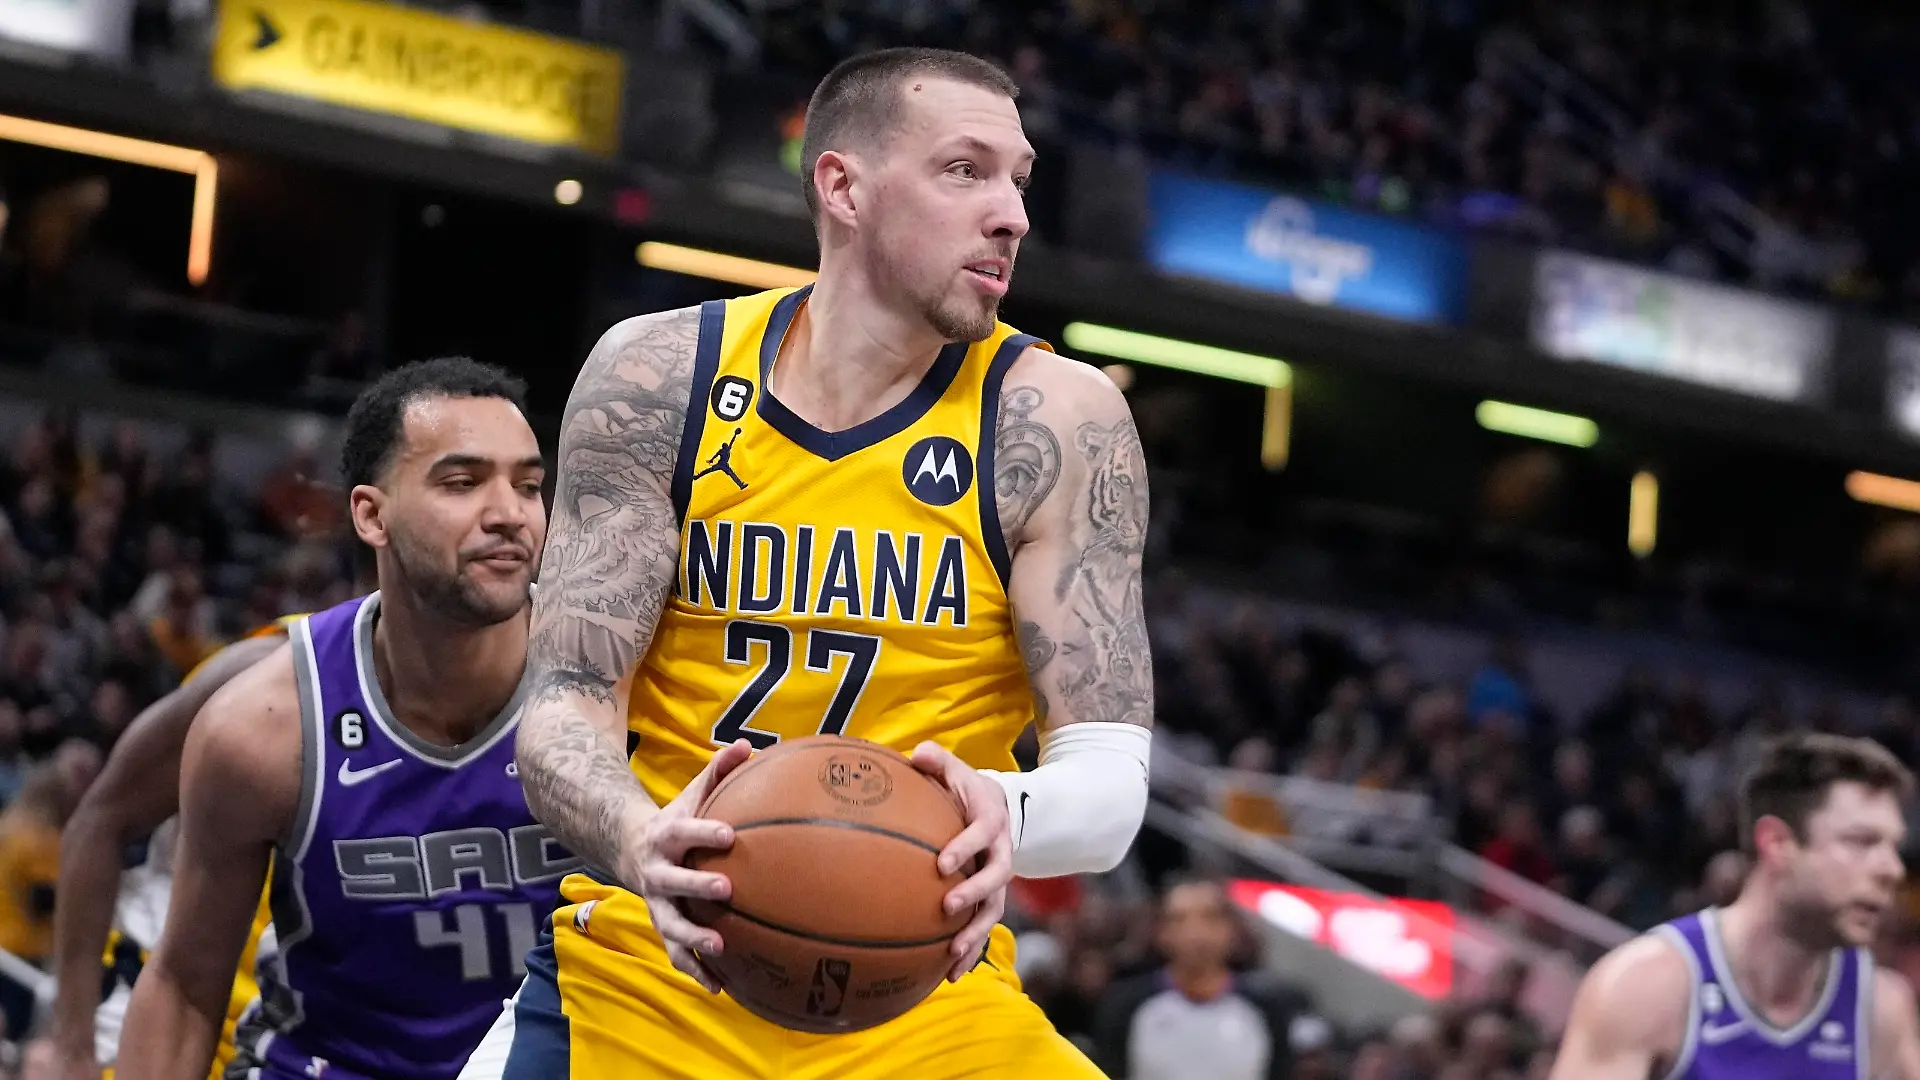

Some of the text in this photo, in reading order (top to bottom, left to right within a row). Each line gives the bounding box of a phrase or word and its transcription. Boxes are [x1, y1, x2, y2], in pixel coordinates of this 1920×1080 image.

[717, 381, 746, 417] 6
[677, 519, 968, 628] NDIANA
[710, 620, 882, 751] 27
[340, 712, 363, 747] 6
[333, 825, 585, 898] SAC
[414, 903, 535, 981] 41
